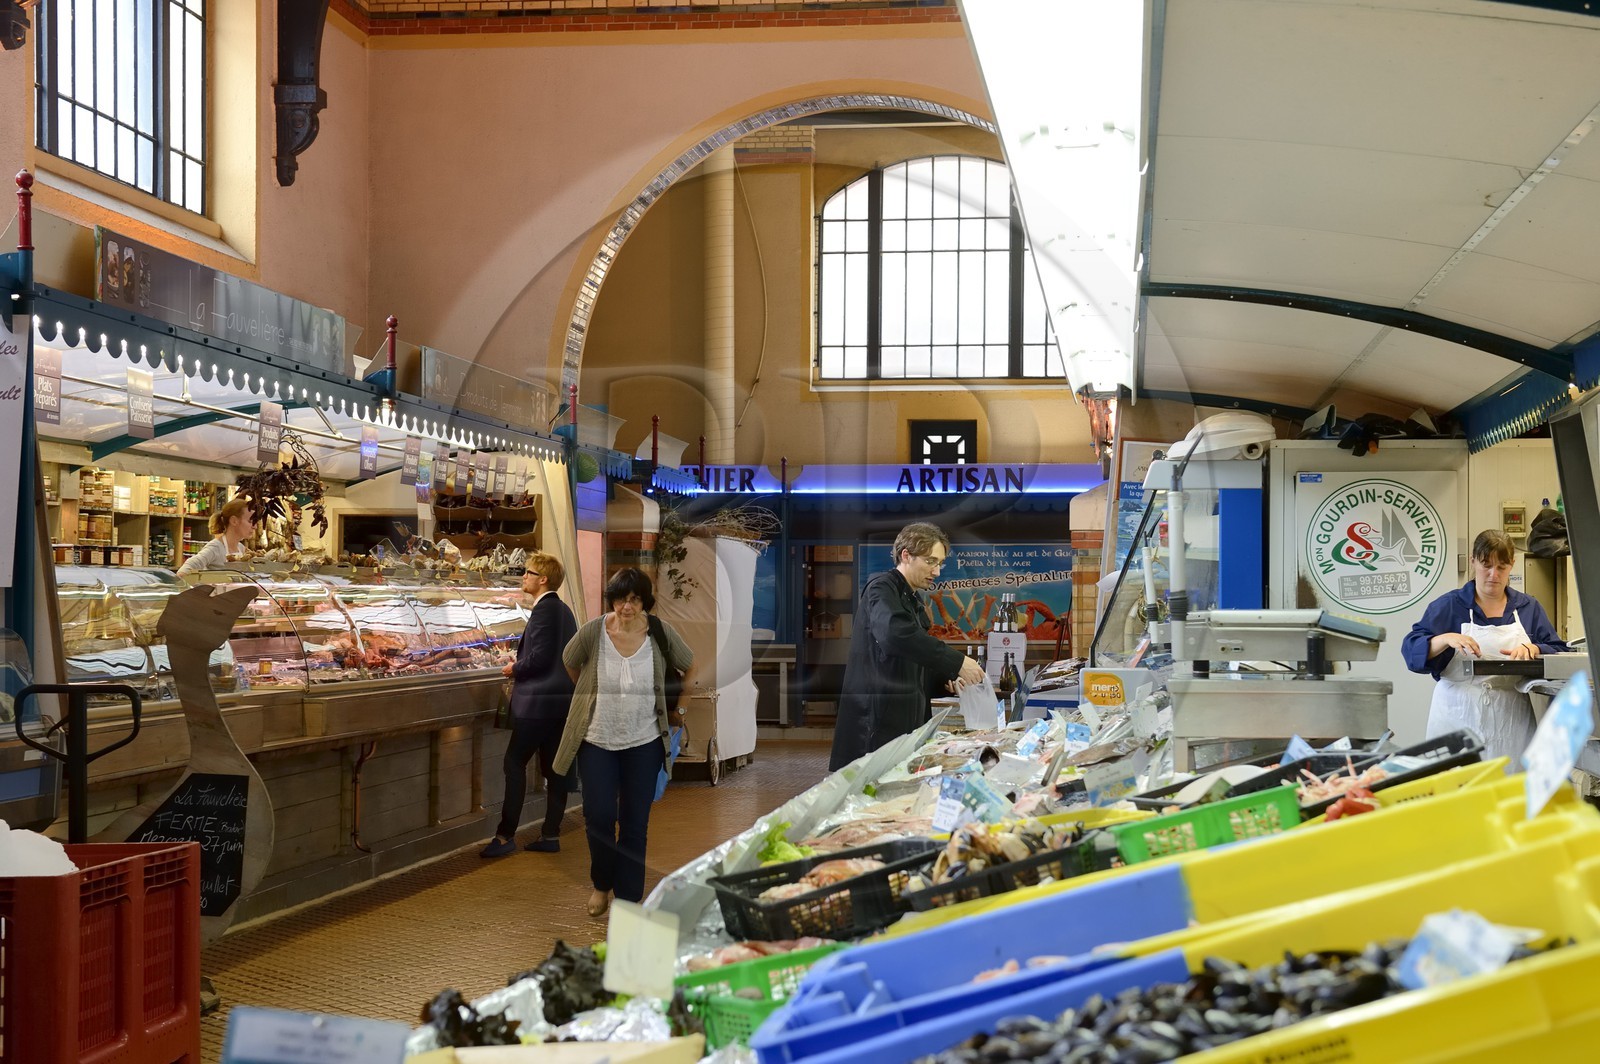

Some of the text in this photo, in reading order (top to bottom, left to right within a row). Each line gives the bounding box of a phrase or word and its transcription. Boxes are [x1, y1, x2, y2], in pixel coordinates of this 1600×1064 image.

[189, 269, 285, 345] La Fauvelière
[38, 376, 52, 393] Plats
[896, 467, 1024, 492] ARTISAN
[924, 577, 1000, 591] ombreuses
[1359, 572, 1407, 585] 99.79.56.79
[200, 874, 236, 896] uillet
